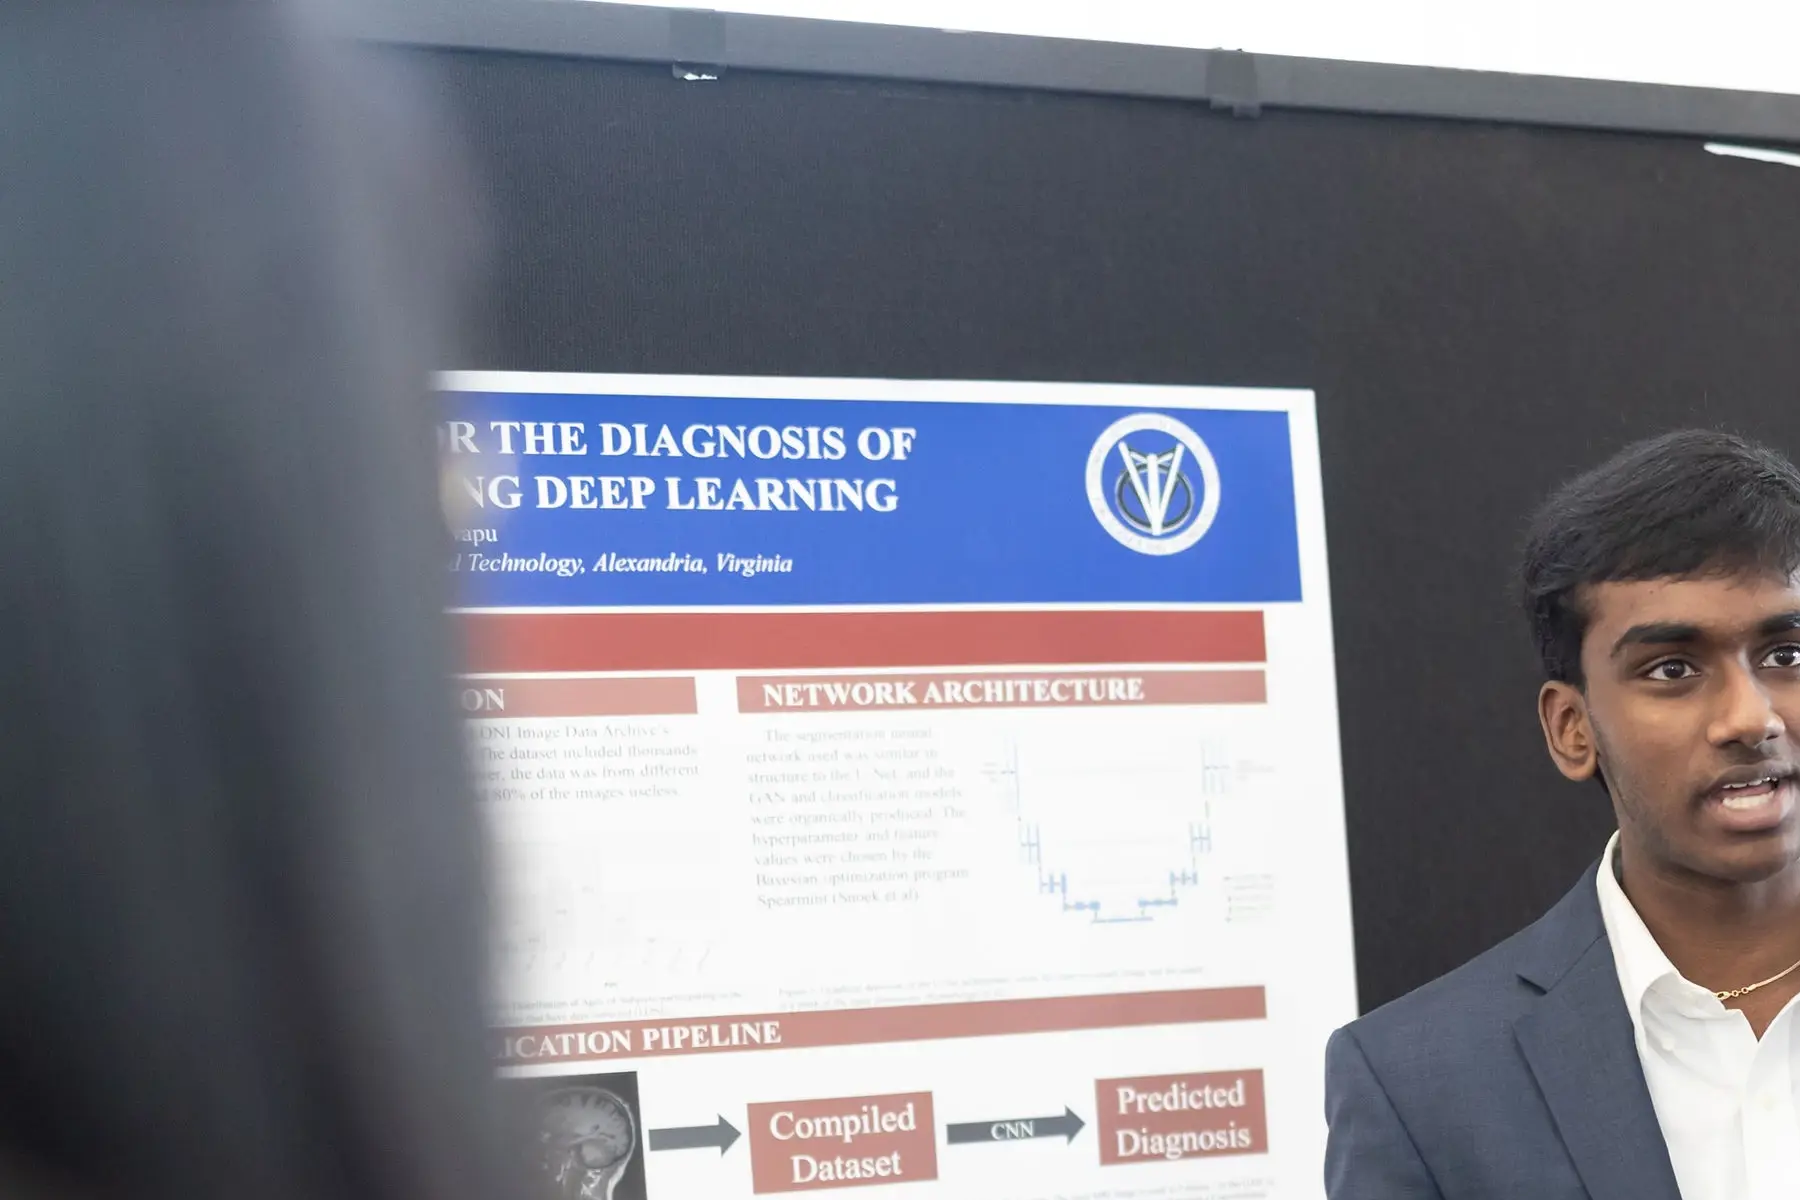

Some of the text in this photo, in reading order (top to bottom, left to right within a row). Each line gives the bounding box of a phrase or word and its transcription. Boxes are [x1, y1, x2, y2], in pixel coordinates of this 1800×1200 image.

[490, 421, 588, 456] THE
[599, 422, 846, 460] DIAGNOSIS
[857, 427, 916, 460] OF
[534, 475, 656, 509] DEEP
[665, 477, 898, 512] LEARNING
[469, 551, 793, 578] Technology, Alexandria, Virginia
[763, 677, 1145, 706] NETWORK ARCHITECTURE
[565, 726, 598, 738] Data
[509, 745, 558, 760] dataset
[564, 745, 622, 759] included
[746, 750, 802, 764] network
[510, 766, 532, 781] the
[747, 770, 808, 784] structure
[530, 787, 546, 800] of
[549, 787, 570, 800] the
[643, 1021, 782, 1052] PIPELINE
[1116, 1079, 1246, 1116] Predicted
[769, 1102, 917, 1144] Compiled
[990, 1120, 1036, 1141] CNN
[1116, 1120, 1252, 1162] Diagnosis
[791, 1150, 902, 1184] Dataset
